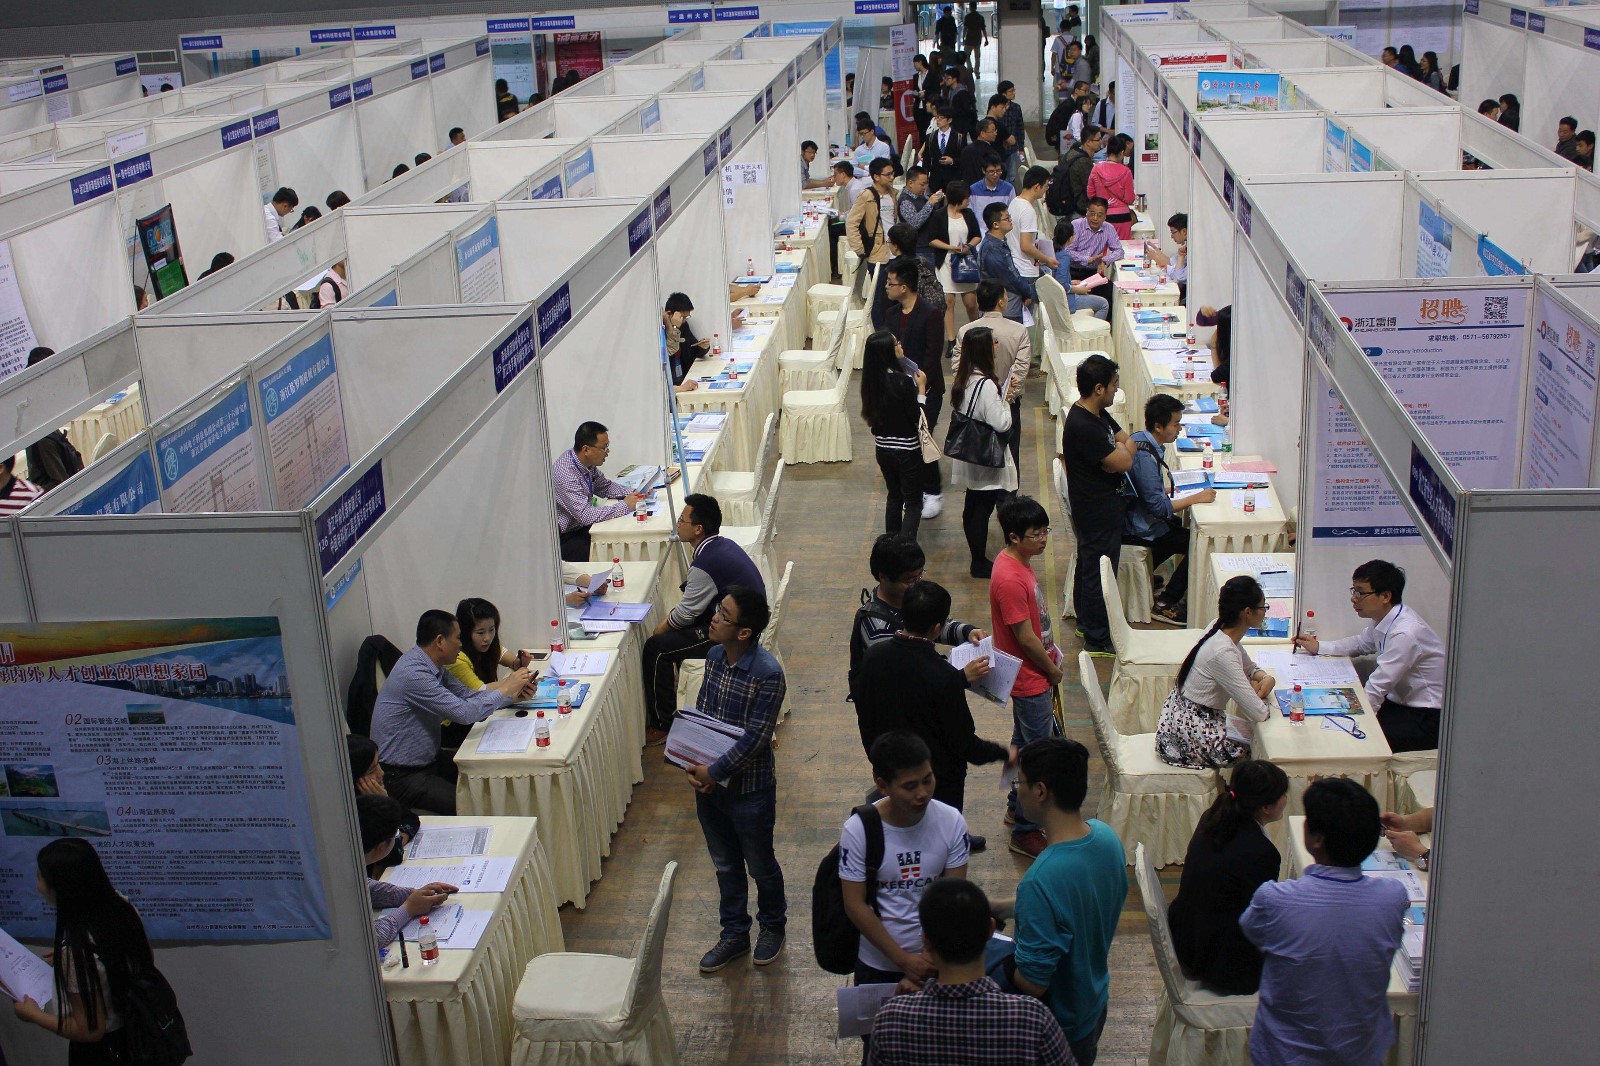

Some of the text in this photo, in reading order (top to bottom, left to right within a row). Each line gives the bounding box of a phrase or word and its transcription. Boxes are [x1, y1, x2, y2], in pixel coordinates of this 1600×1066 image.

[1420, 298, 1468, 319] 招聘
[1354, 316, 1397, 328] 浙江雷博
[318, 535, 329, 552] 126
[65, 713, 82, 726] 02
[96, 755, 112, 766] 03
[116, 806, 132, 816] 04
